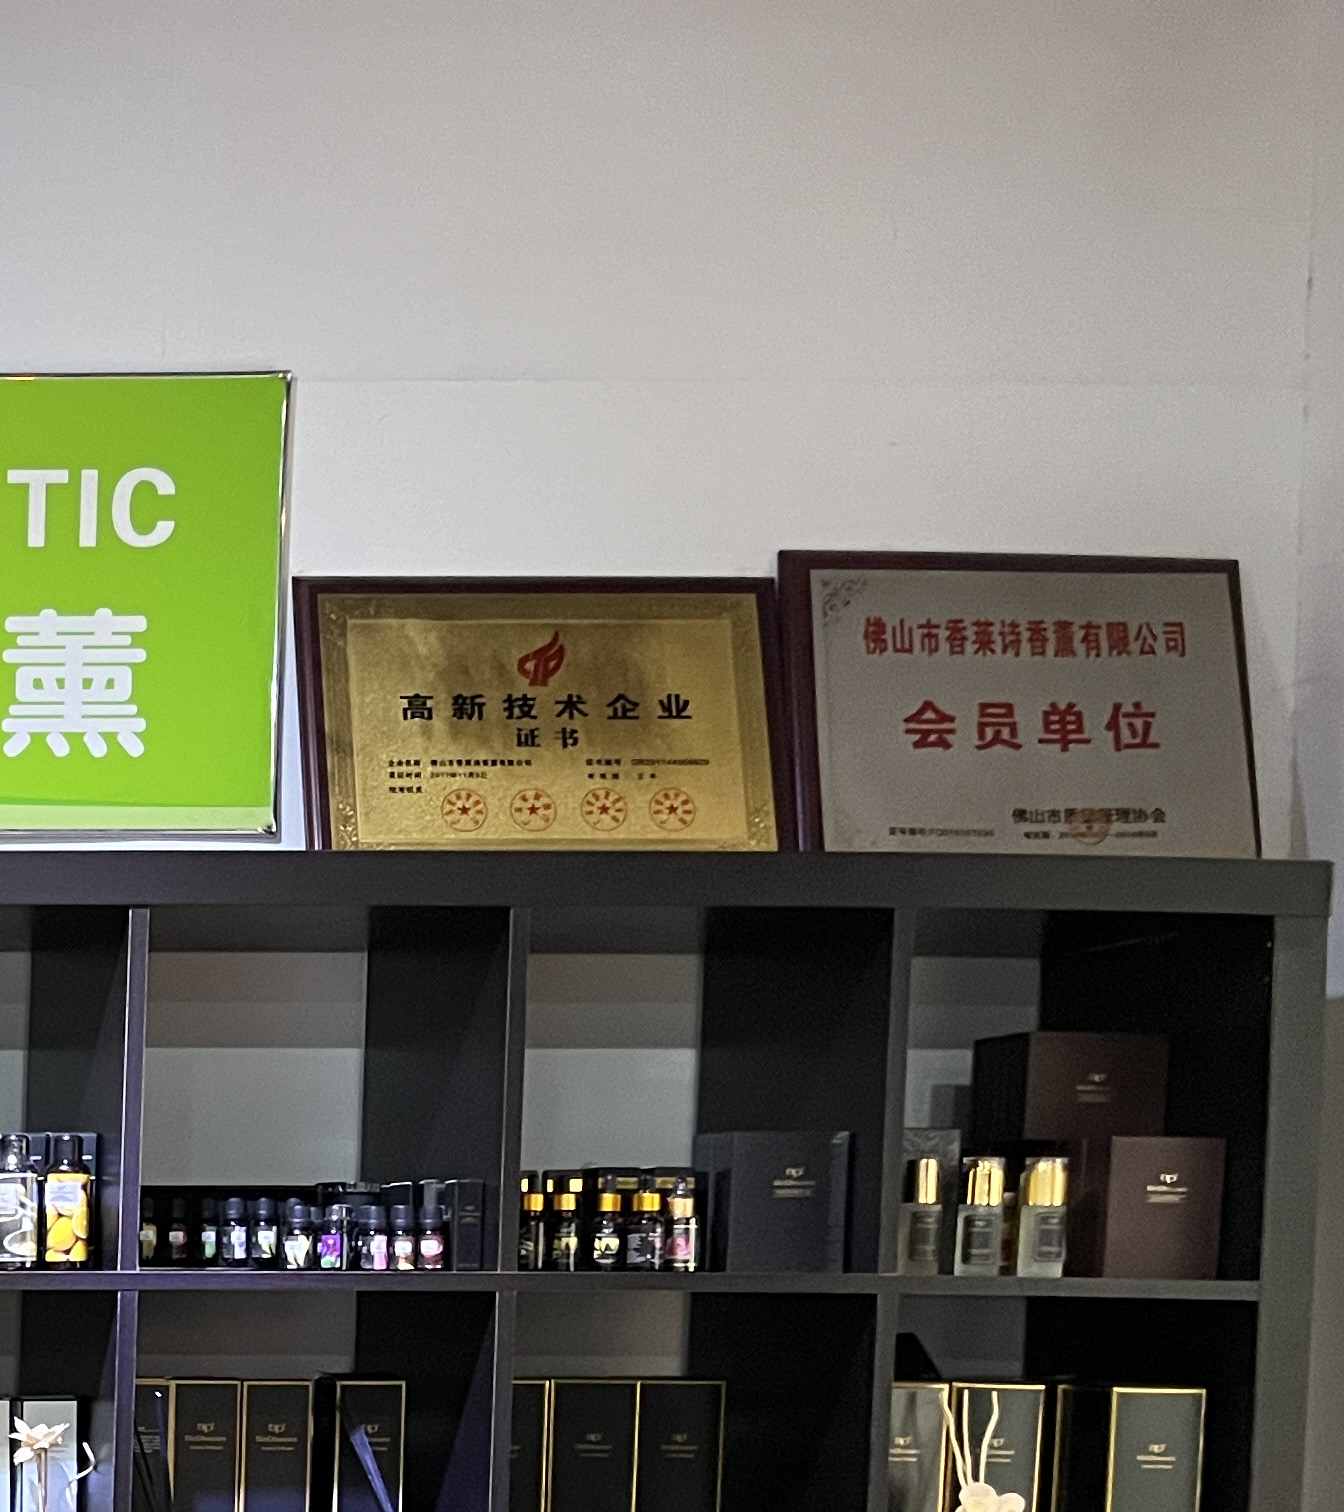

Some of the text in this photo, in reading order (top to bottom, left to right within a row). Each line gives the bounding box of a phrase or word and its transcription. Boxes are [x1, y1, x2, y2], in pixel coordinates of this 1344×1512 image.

[399, 693, 693, 721] 高新技术企业
[516, 727, 581, 748] 证书
[903, 700, 1161, 752] 会员单位
